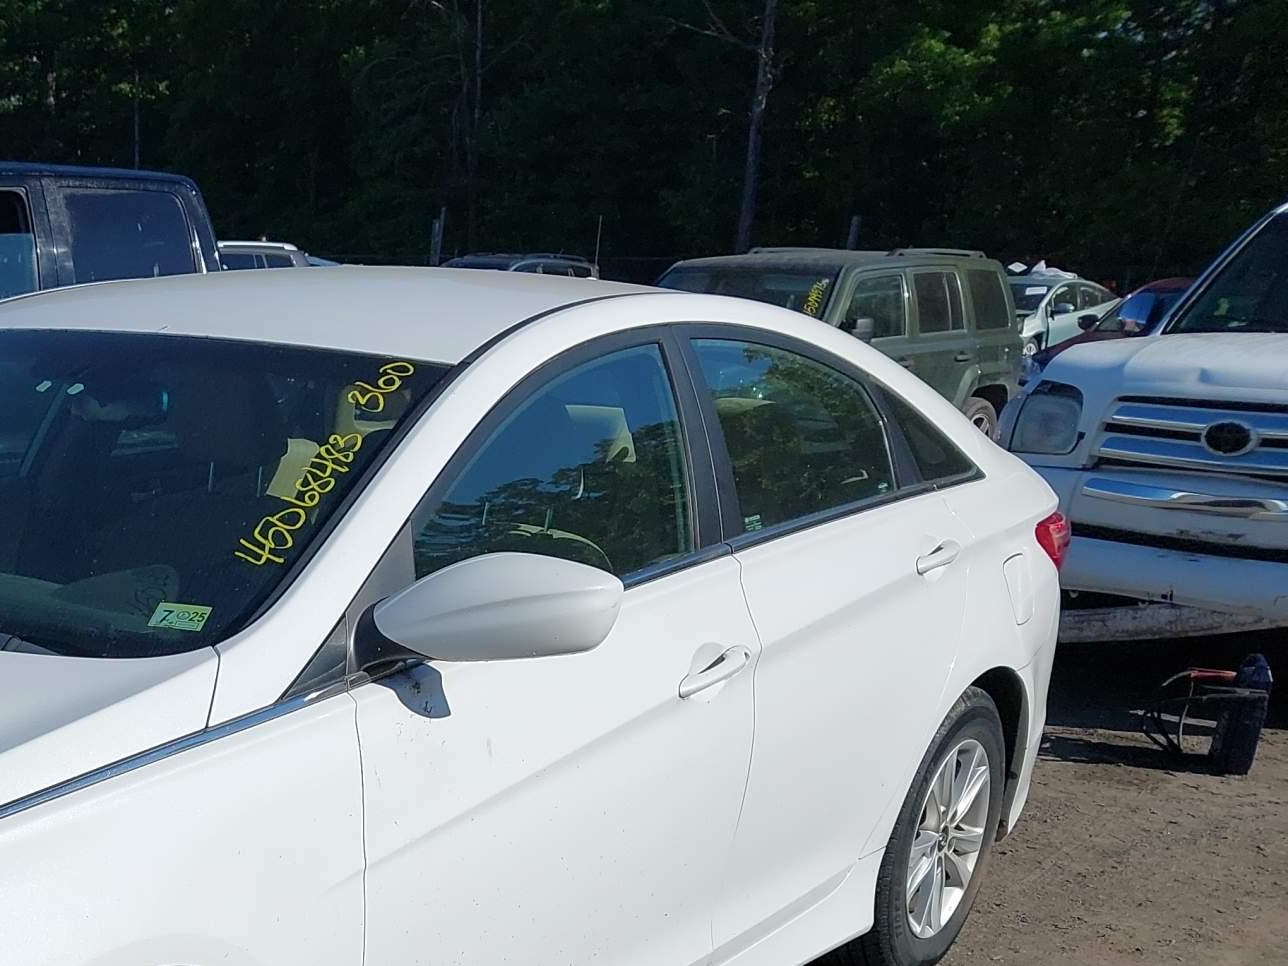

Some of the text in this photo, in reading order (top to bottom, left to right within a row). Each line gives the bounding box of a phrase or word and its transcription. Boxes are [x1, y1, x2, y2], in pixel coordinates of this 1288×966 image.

[234, 361, 414, 565] 45068483 360
[159, 609, 207, 624] 7 25
